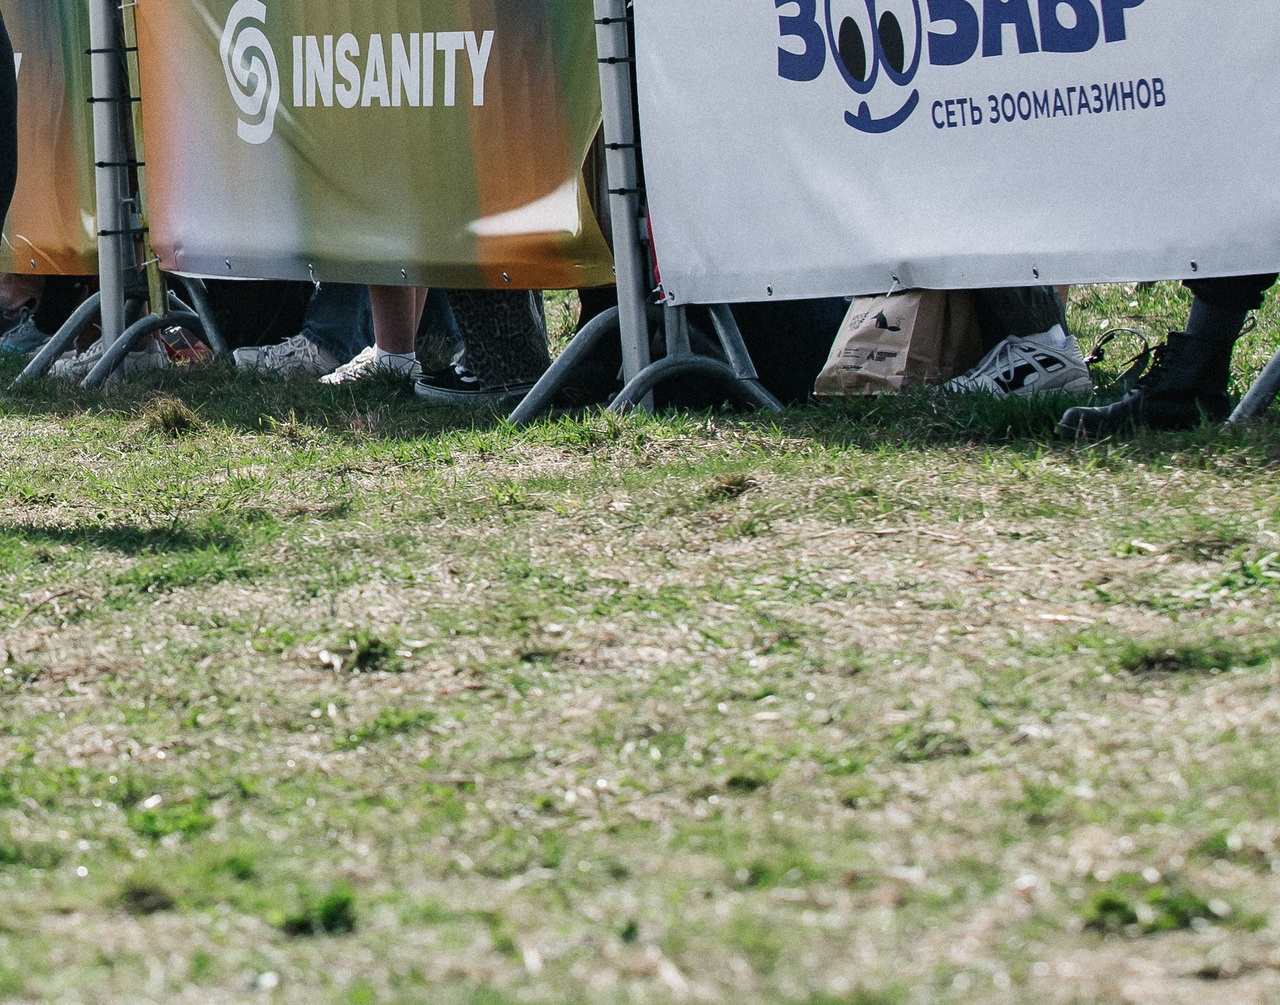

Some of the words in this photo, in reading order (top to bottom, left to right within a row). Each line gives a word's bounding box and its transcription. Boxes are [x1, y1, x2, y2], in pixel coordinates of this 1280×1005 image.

[292, 29, 495, 107] INSANITY
[931, 97, 983, 130] СЕТЬ
[987, 77, 1166, 124] ЗООМАГАЗИНОВ
